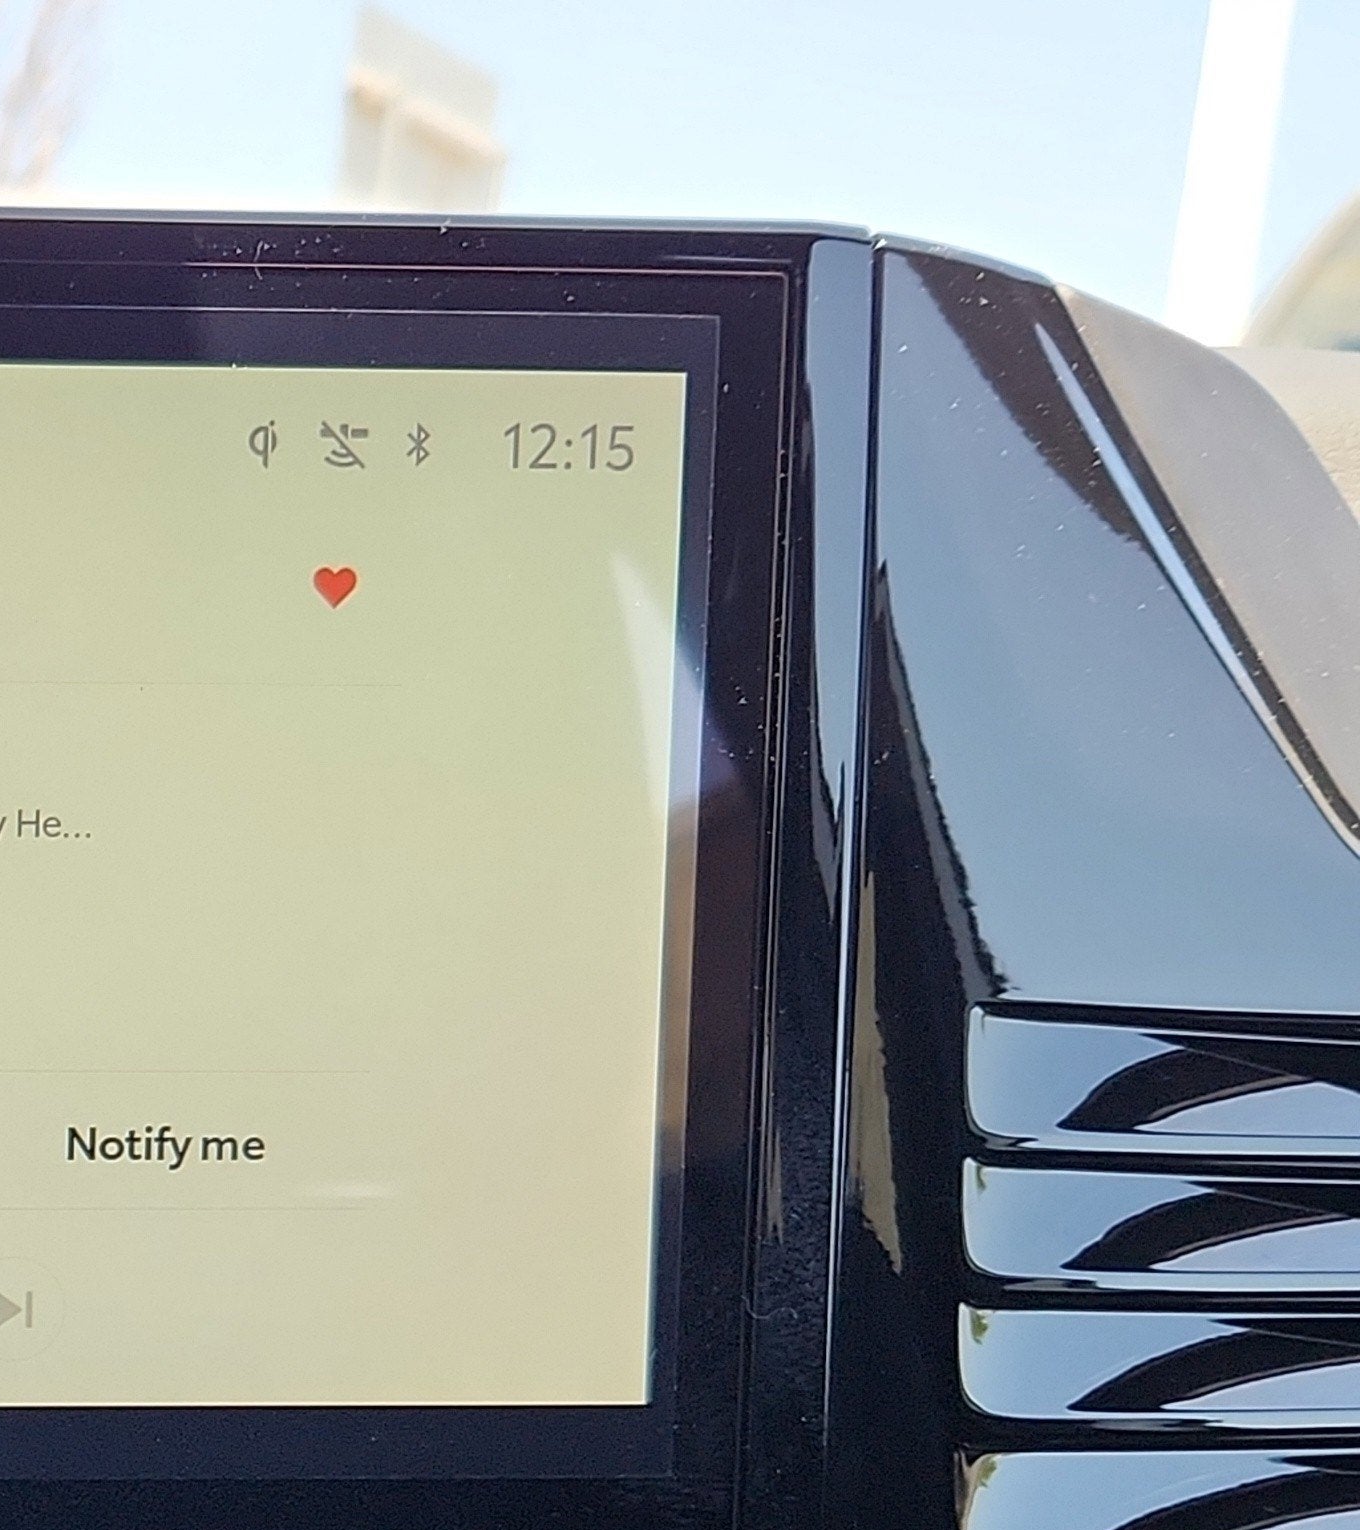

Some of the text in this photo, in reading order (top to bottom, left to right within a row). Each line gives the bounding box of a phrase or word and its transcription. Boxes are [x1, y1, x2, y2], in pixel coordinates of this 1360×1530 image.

[503, 422, 635, 472] 12:15
[66, 1124, 266, 1171] Notify me
